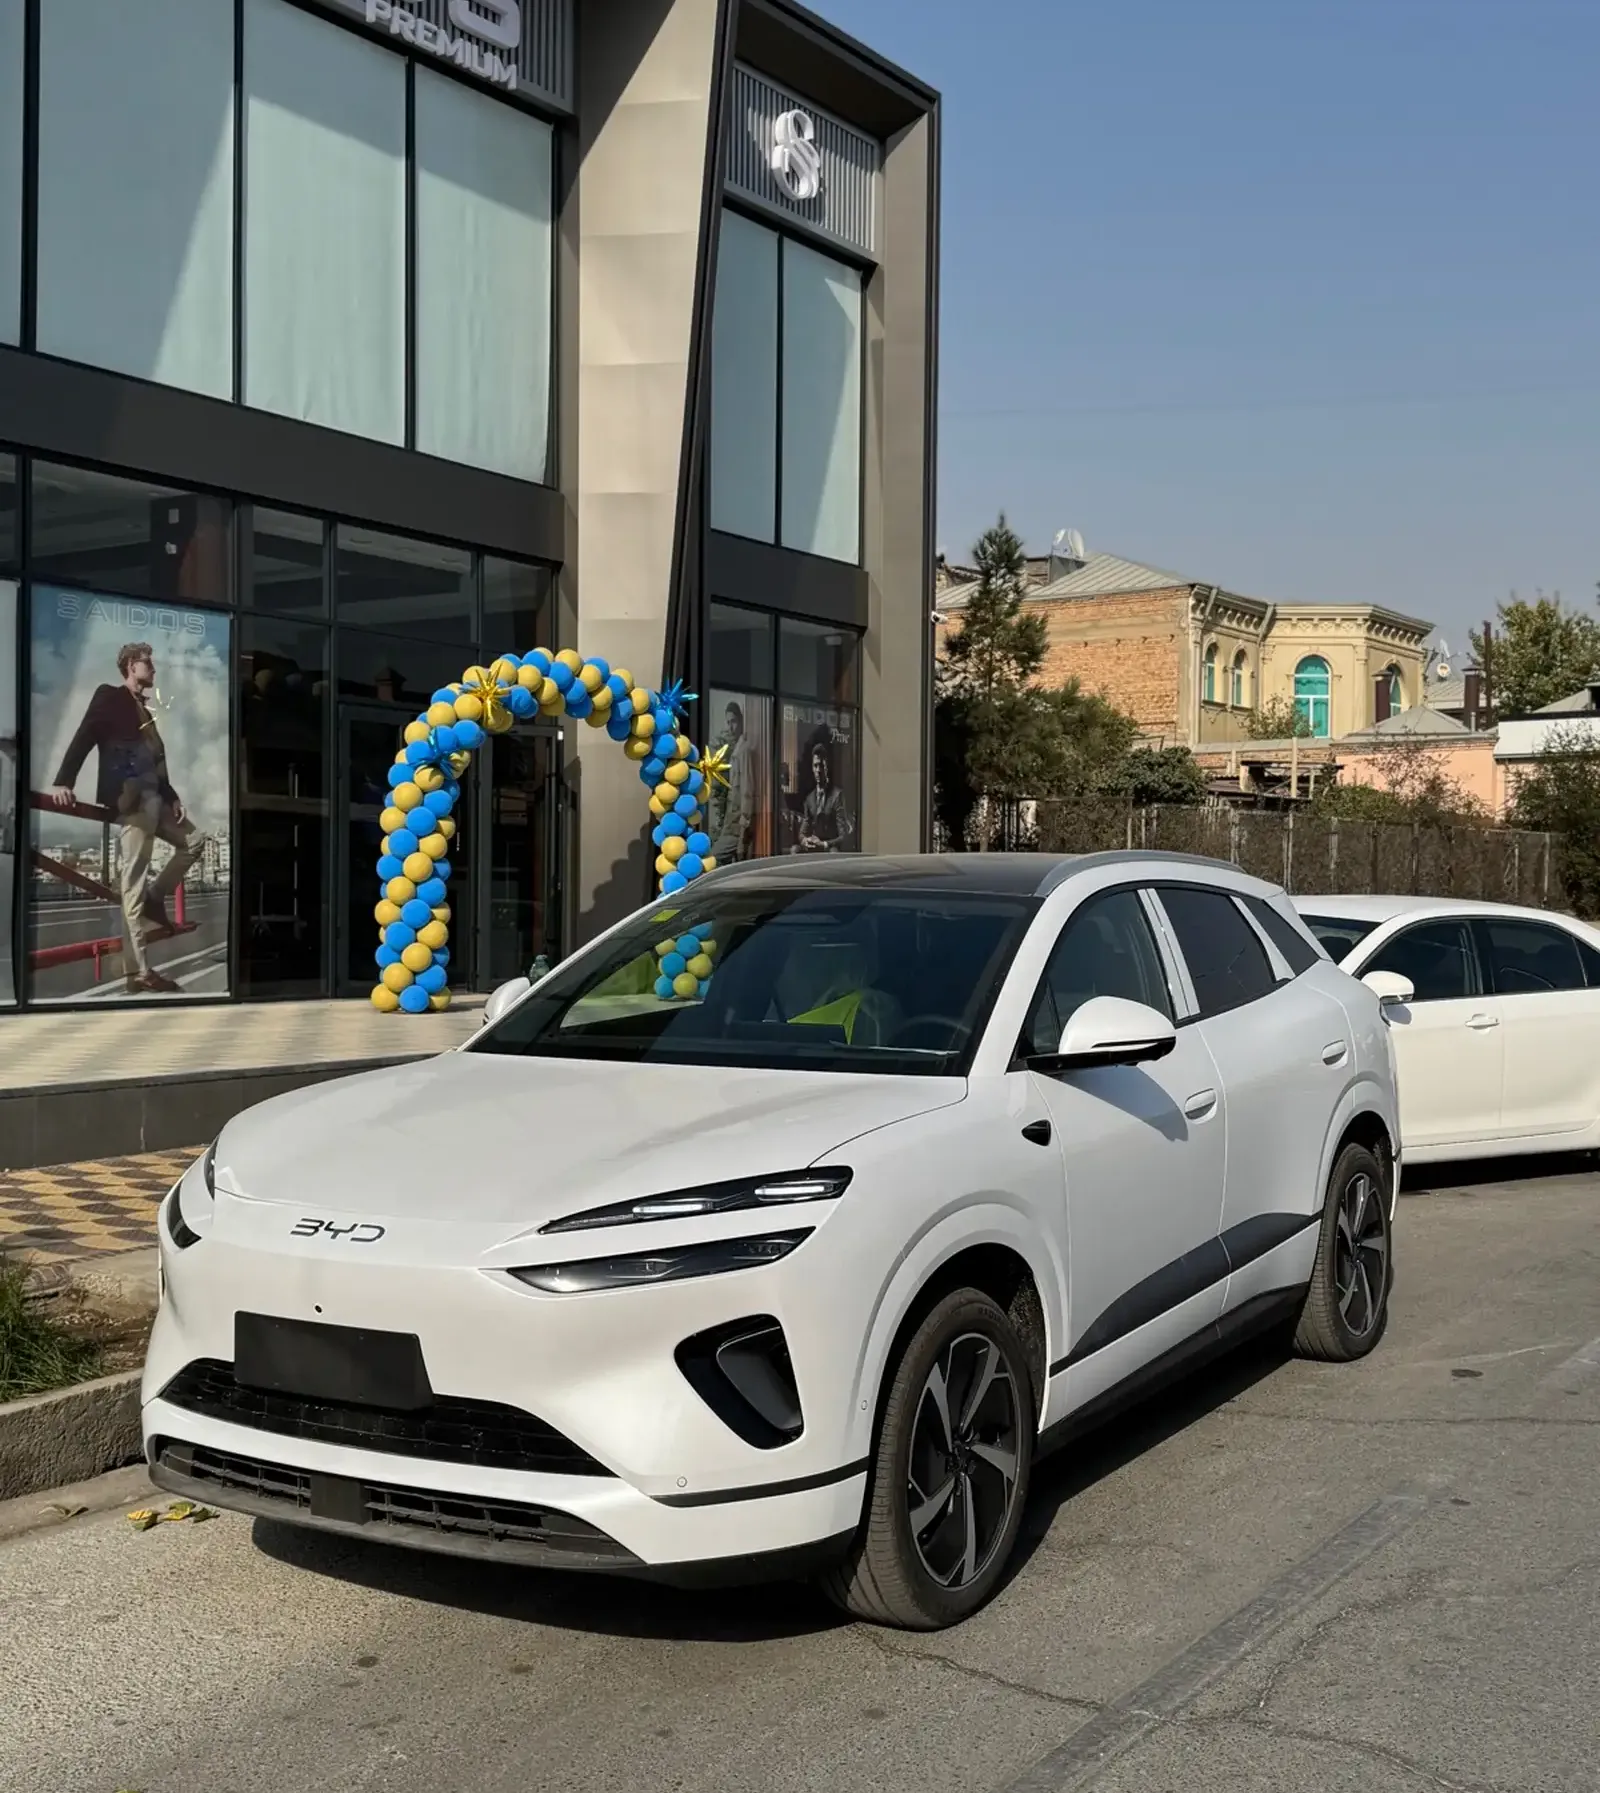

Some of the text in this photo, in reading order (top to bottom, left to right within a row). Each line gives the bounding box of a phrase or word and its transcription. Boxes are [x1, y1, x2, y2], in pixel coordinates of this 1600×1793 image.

[364, 0, 518, 90] PREMIUM
[57, 593, 206, 637] SAIDOS
[290, 1217, 386, 1242] BYD
